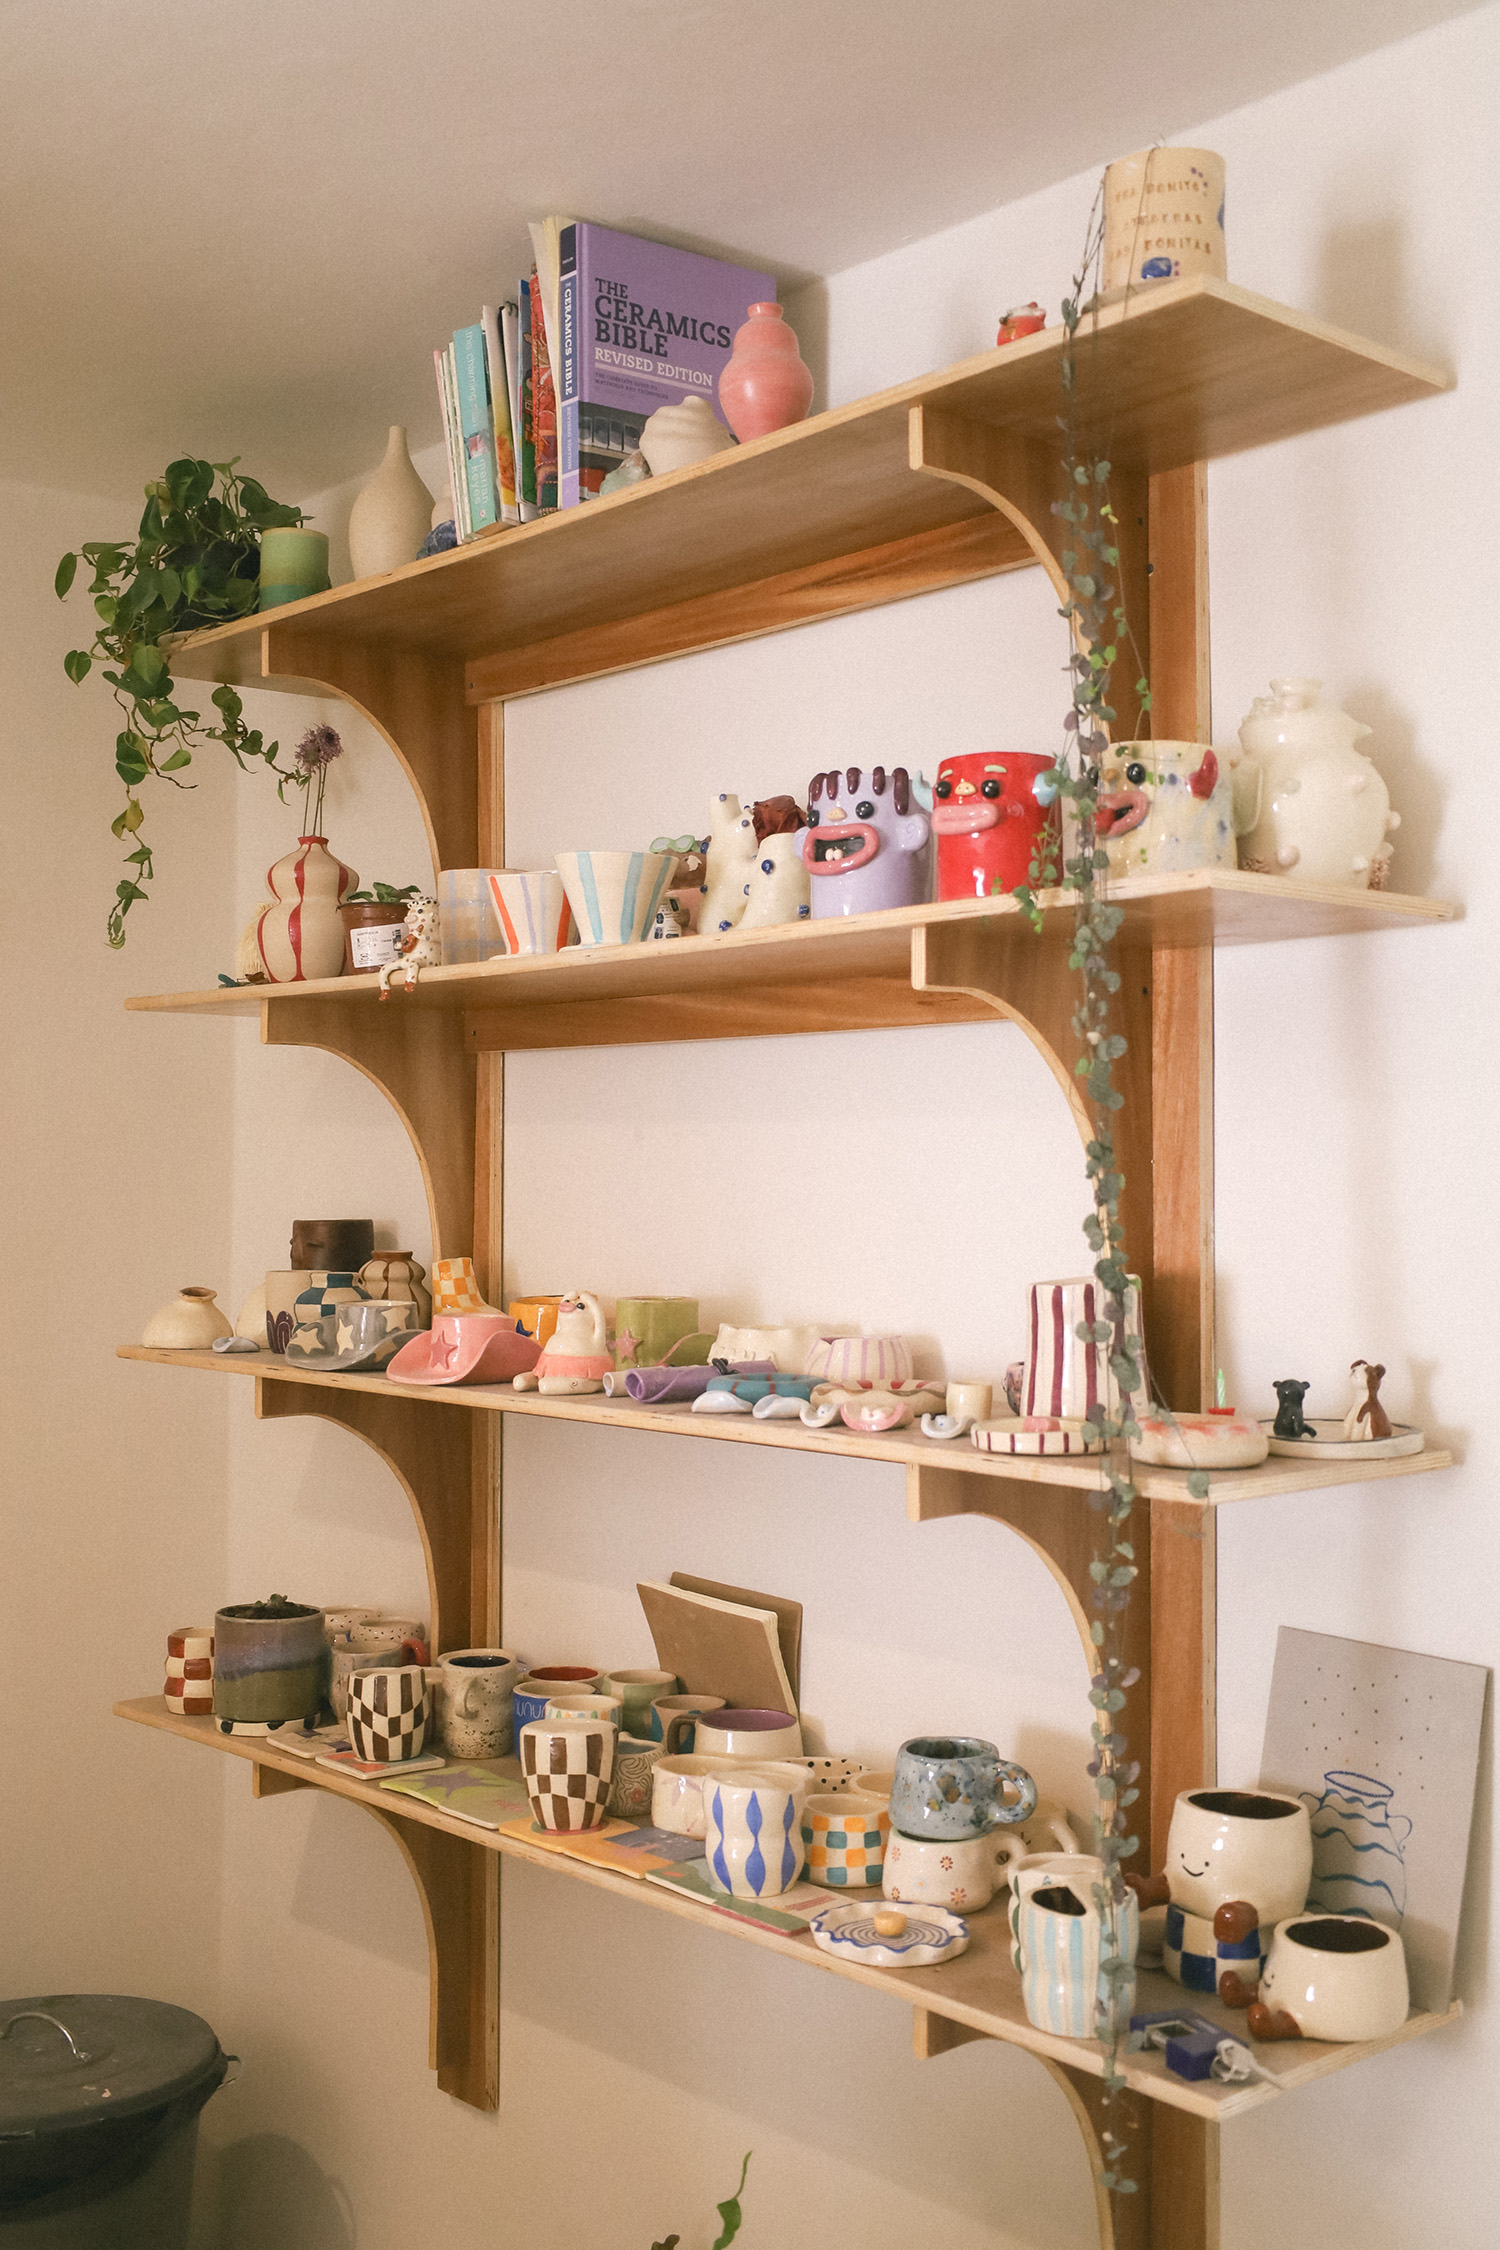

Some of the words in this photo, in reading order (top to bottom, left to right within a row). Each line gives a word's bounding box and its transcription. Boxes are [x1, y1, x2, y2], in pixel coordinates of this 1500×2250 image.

[595, 277, 628, 299] THE
[465, 331, 473, 350] this
[564, 288, 573, 356] CERAMICS
[594, 295, 731, 349] CERAMICS
[594, 318, 668, 358] BIBLE
[466, 353, 477, 401] charming
[564, 358, 573, 395] BIBLE
[594, 347, 653, 372] REVISED
[656, 361, 713, 387] EDITION
[471, 465, 481, 505] keyes
[479, 458, 490, 504] marian
